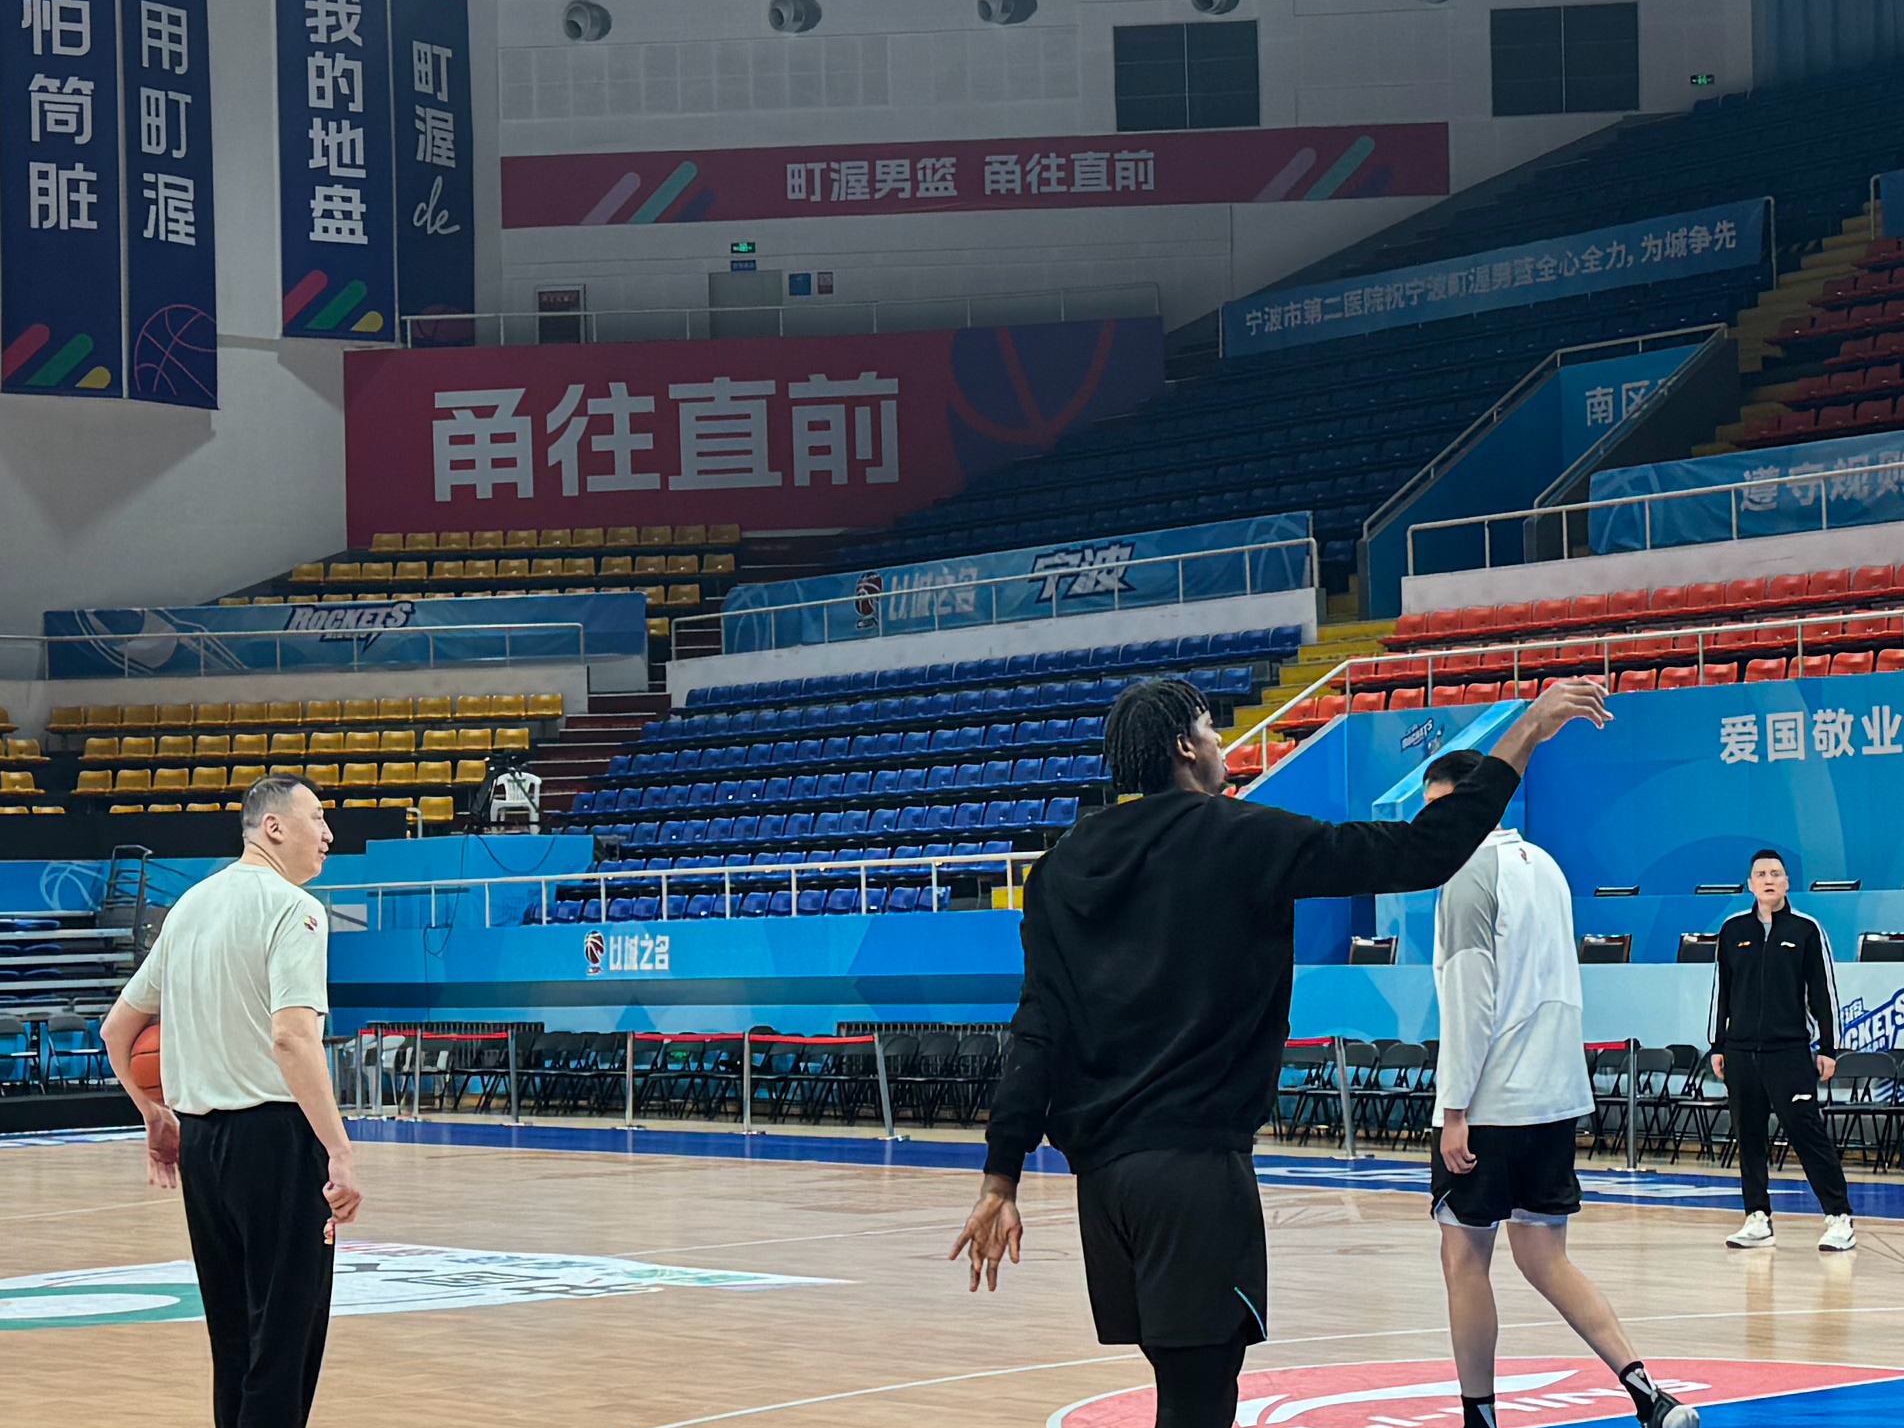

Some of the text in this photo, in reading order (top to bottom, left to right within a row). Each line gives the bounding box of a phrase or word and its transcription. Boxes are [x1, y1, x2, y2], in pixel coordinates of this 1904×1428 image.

[140, 0, 196, 247] 用町渥
[412, 40, 456, 170] 町渥
[786, 150, 1156, 203] 町渥男篮 甬往直前
[432, 370, 899, 505] 甬往直前
[286, 601, 414, 632] ROCKETS
[1028, 541, 1137, 603] 宁波
